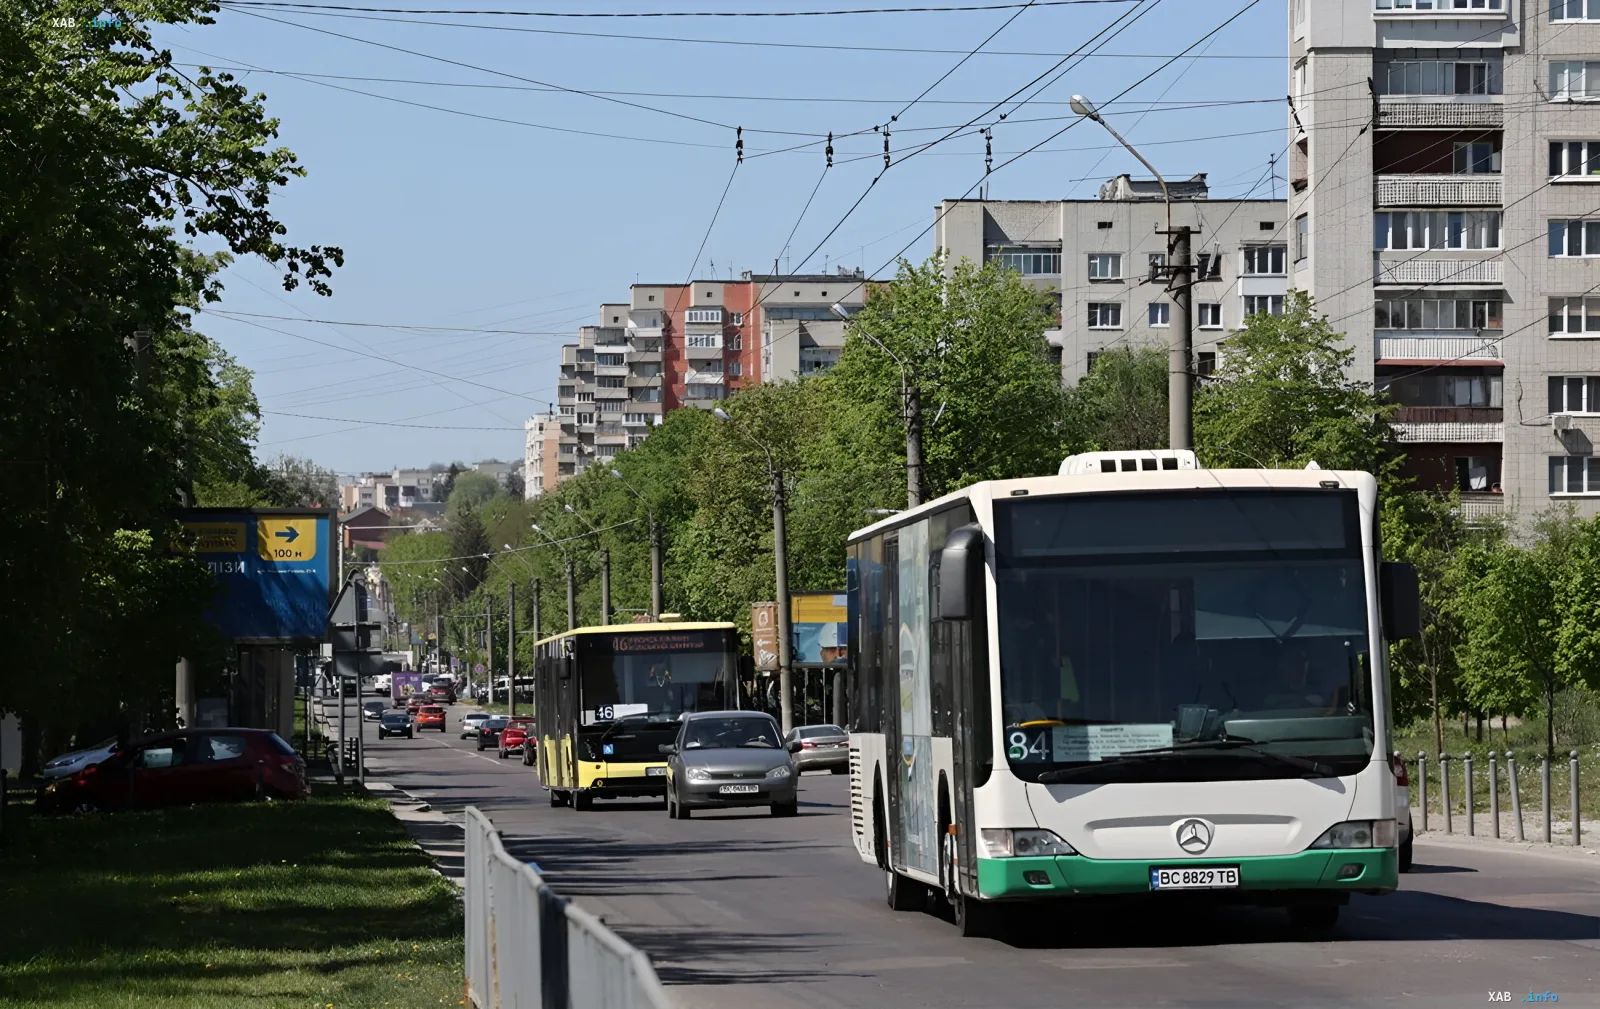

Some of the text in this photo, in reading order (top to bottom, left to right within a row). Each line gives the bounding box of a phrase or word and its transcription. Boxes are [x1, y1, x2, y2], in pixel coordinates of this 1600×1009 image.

[274, 549, 292, 558] 100
[596, 706, 613, 719] 46
[1009, 731, 1049, 760] 84
[1160, 870, 1237, 885] BC 8829 TB
